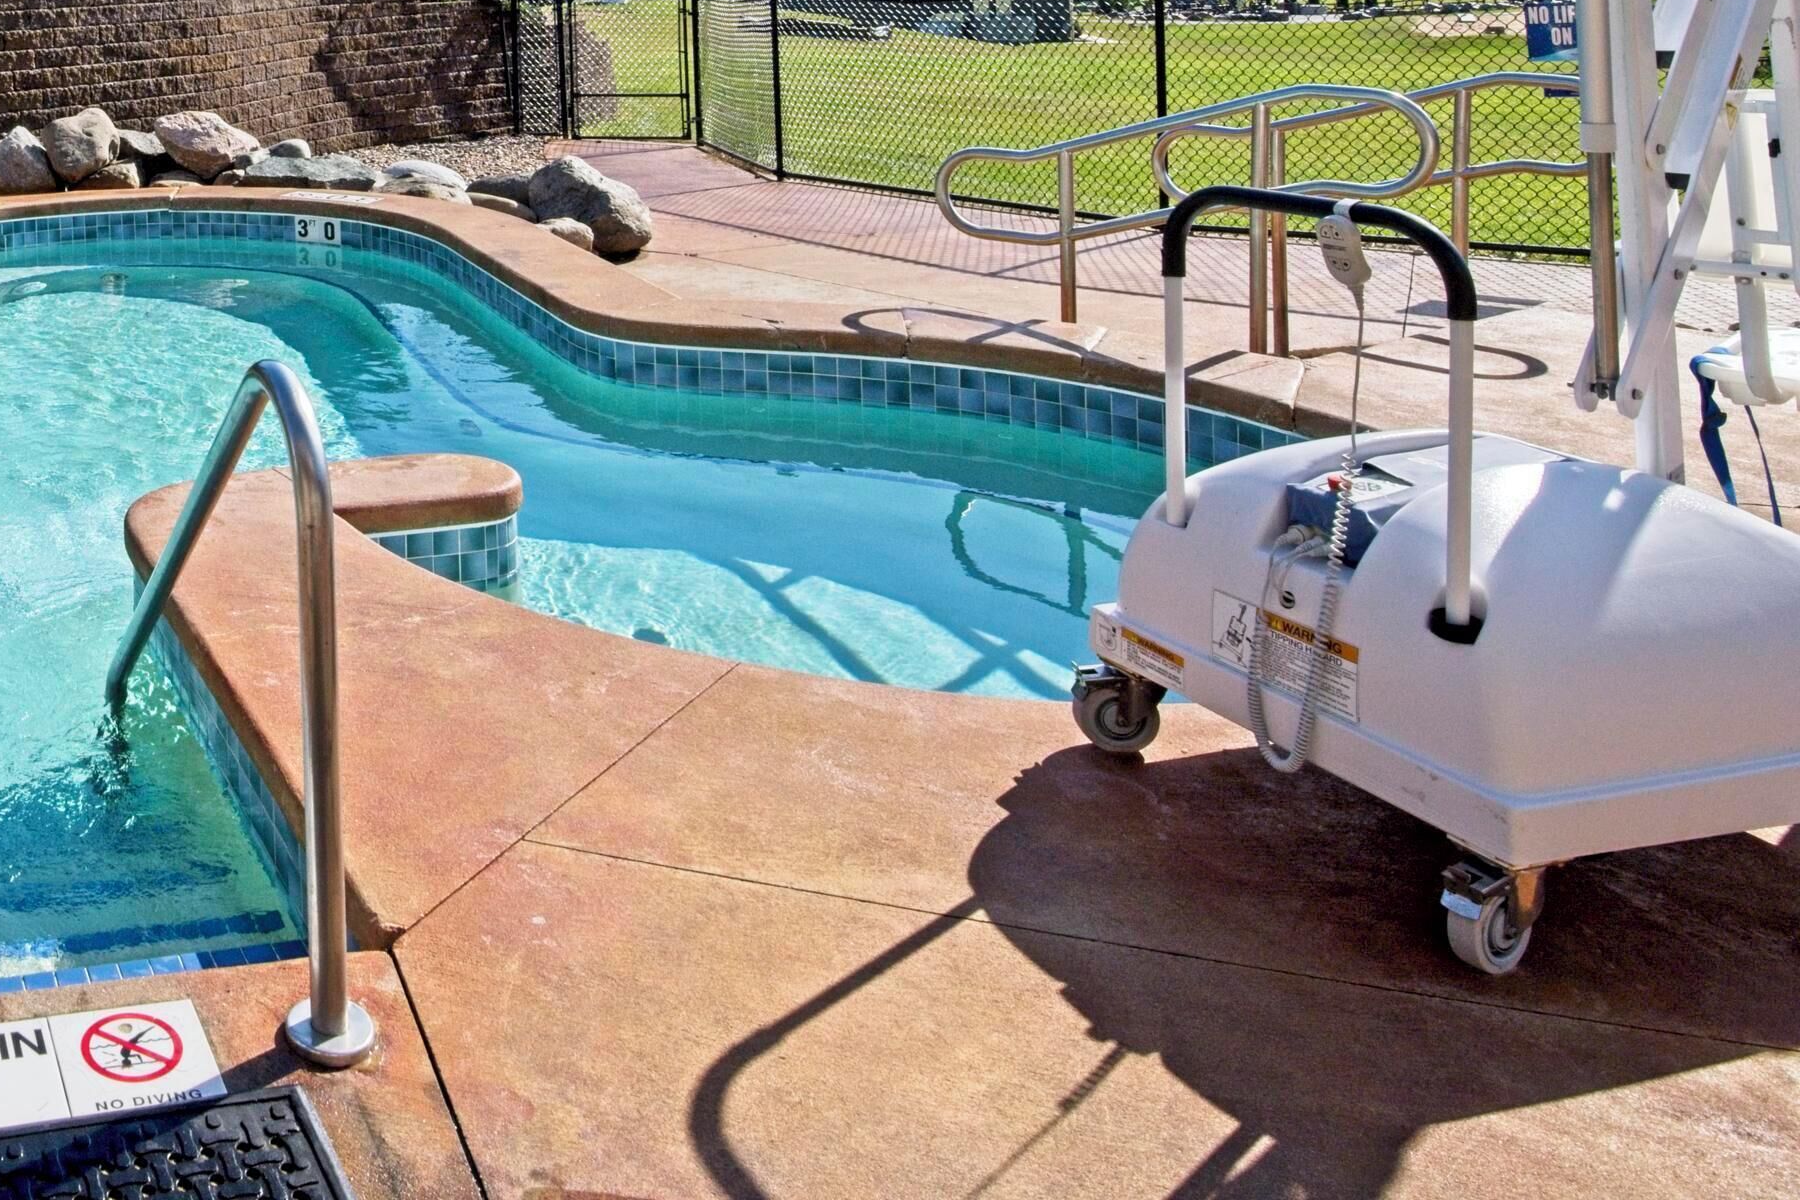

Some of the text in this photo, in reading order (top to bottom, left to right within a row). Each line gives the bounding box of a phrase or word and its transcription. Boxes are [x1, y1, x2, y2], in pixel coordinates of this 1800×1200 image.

[1528, 5, 1576, 24] NO LIF
[1551, 27, 1573, 45] ON
[297, 219, 308, 238] 3
[324, 221, 335, 240] 0
[1271, 631, 1343, 667] TIPPING HARD
[1281, 621, 1342, 654] WARNNG
[0, 1029, 48, 1061] IN
[95, 1088, 203, 1112] NO DIVING
